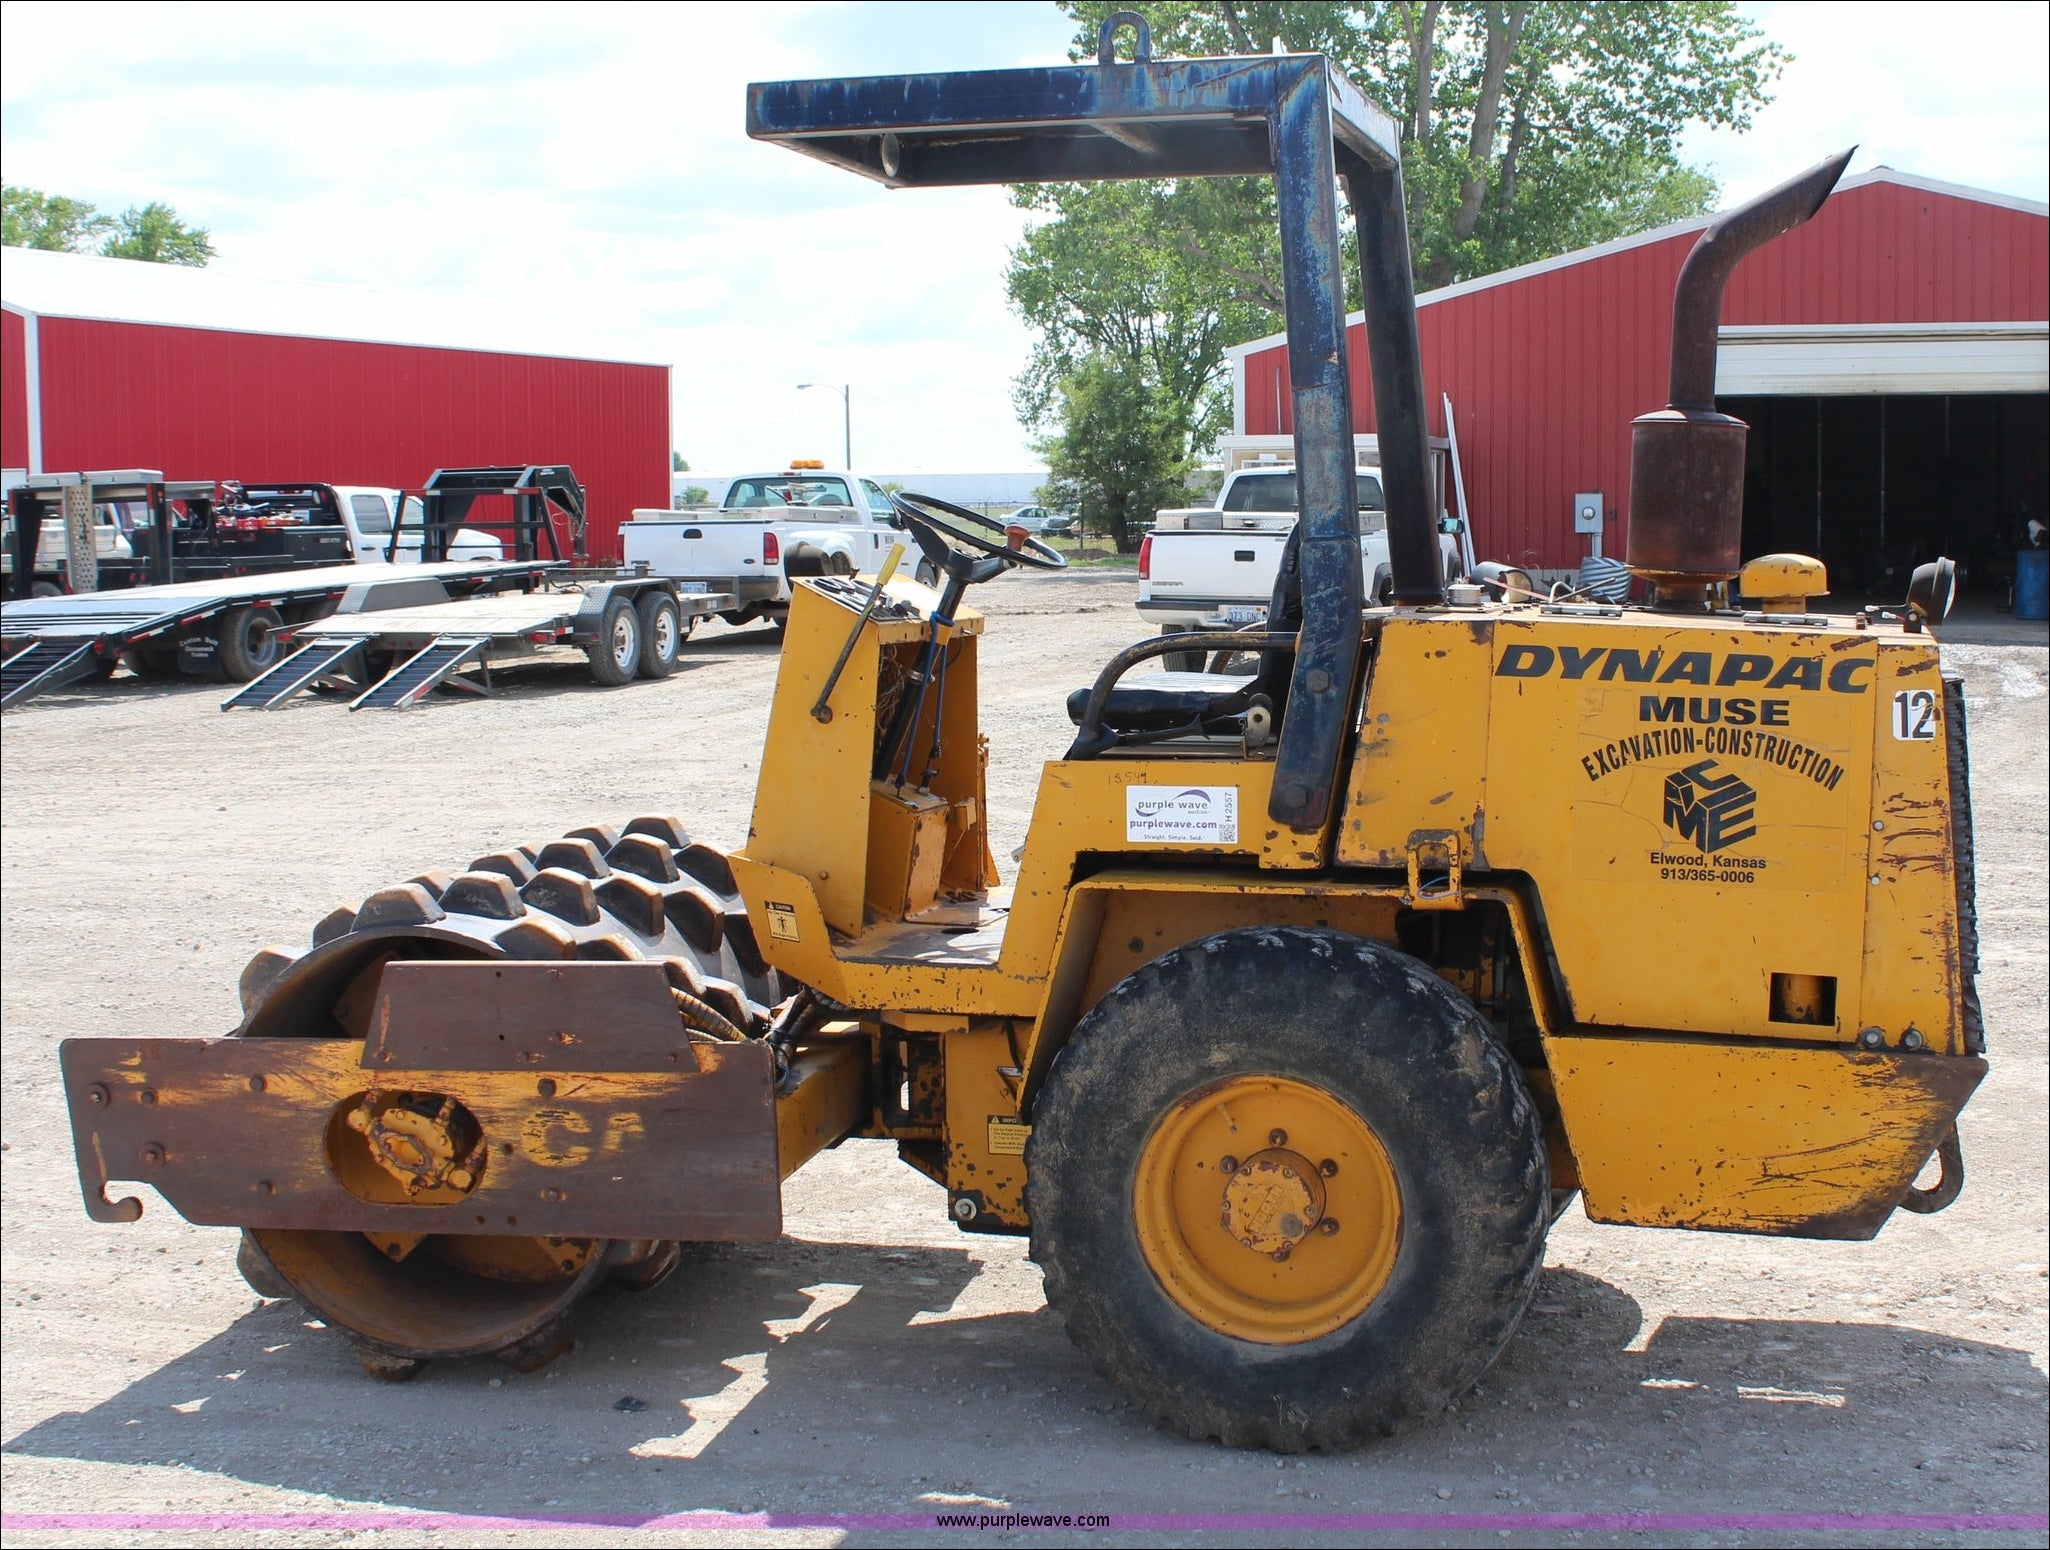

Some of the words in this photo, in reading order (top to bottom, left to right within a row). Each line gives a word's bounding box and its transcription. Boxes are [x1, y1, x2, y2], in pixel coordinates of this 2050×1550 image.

[1494, 643, 1876, 694] DYNAPAC
[1639, 695, 1790, 727] MUSE
[1894, 691, 1934, 739] 12
[1138, 800, 1174, 810] purple
[1178, 802, 1208, 810] wave
[1129, 818, 1218, 830] purplewave.com
[1650, 851, 1708, 868] Elwood,
[1712, 854, 1767, 869] Kansas
[1660, 868, 1755, 884] 913/365-0006
